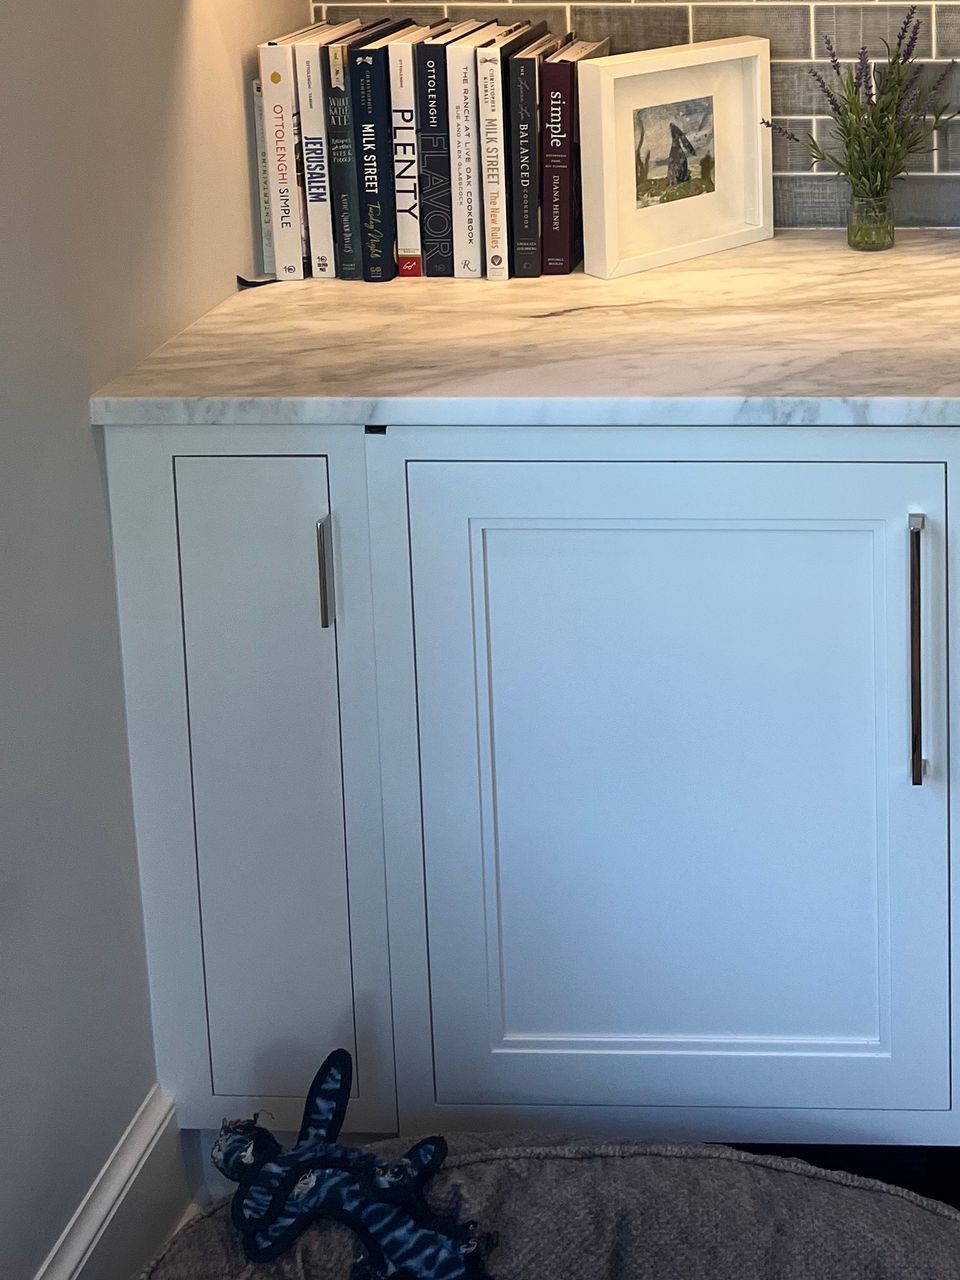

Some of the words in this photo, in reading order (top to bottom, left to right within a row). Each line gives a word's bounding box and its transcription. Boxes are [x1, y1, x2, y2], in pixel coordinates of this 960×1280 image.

[426, 60, 437, 127] OTTOLENGHI
[362, 123, 376, 150] MILK
[464, 125, 470, 138] AT
[485, 118, 498, 144] MILK
[545, 91, 567, 147] simple
[273, 104, 288, 184] OTTOLENGHI
[520, 123, 530, 187] BALANCED
[304, 136, 327, 203] JERUSALEM
[363, 154, 378, 194] STREET
[392, 109, 418, 220] PLENTY
[486, 147, 500, 185] STREET
[278, 188, 291, 228] SIMPLE
[420, 132, 452, 261] FLAVOR
[489, 191, 500, 205] The
[552, 175, 560, 202] DIANA
[466, 191, 474, 244] COOKBOOK
[490, 207, 500, 224] New
[552, 204, 560, 232] HENRY
[491, 226, 500, 249] Rules
